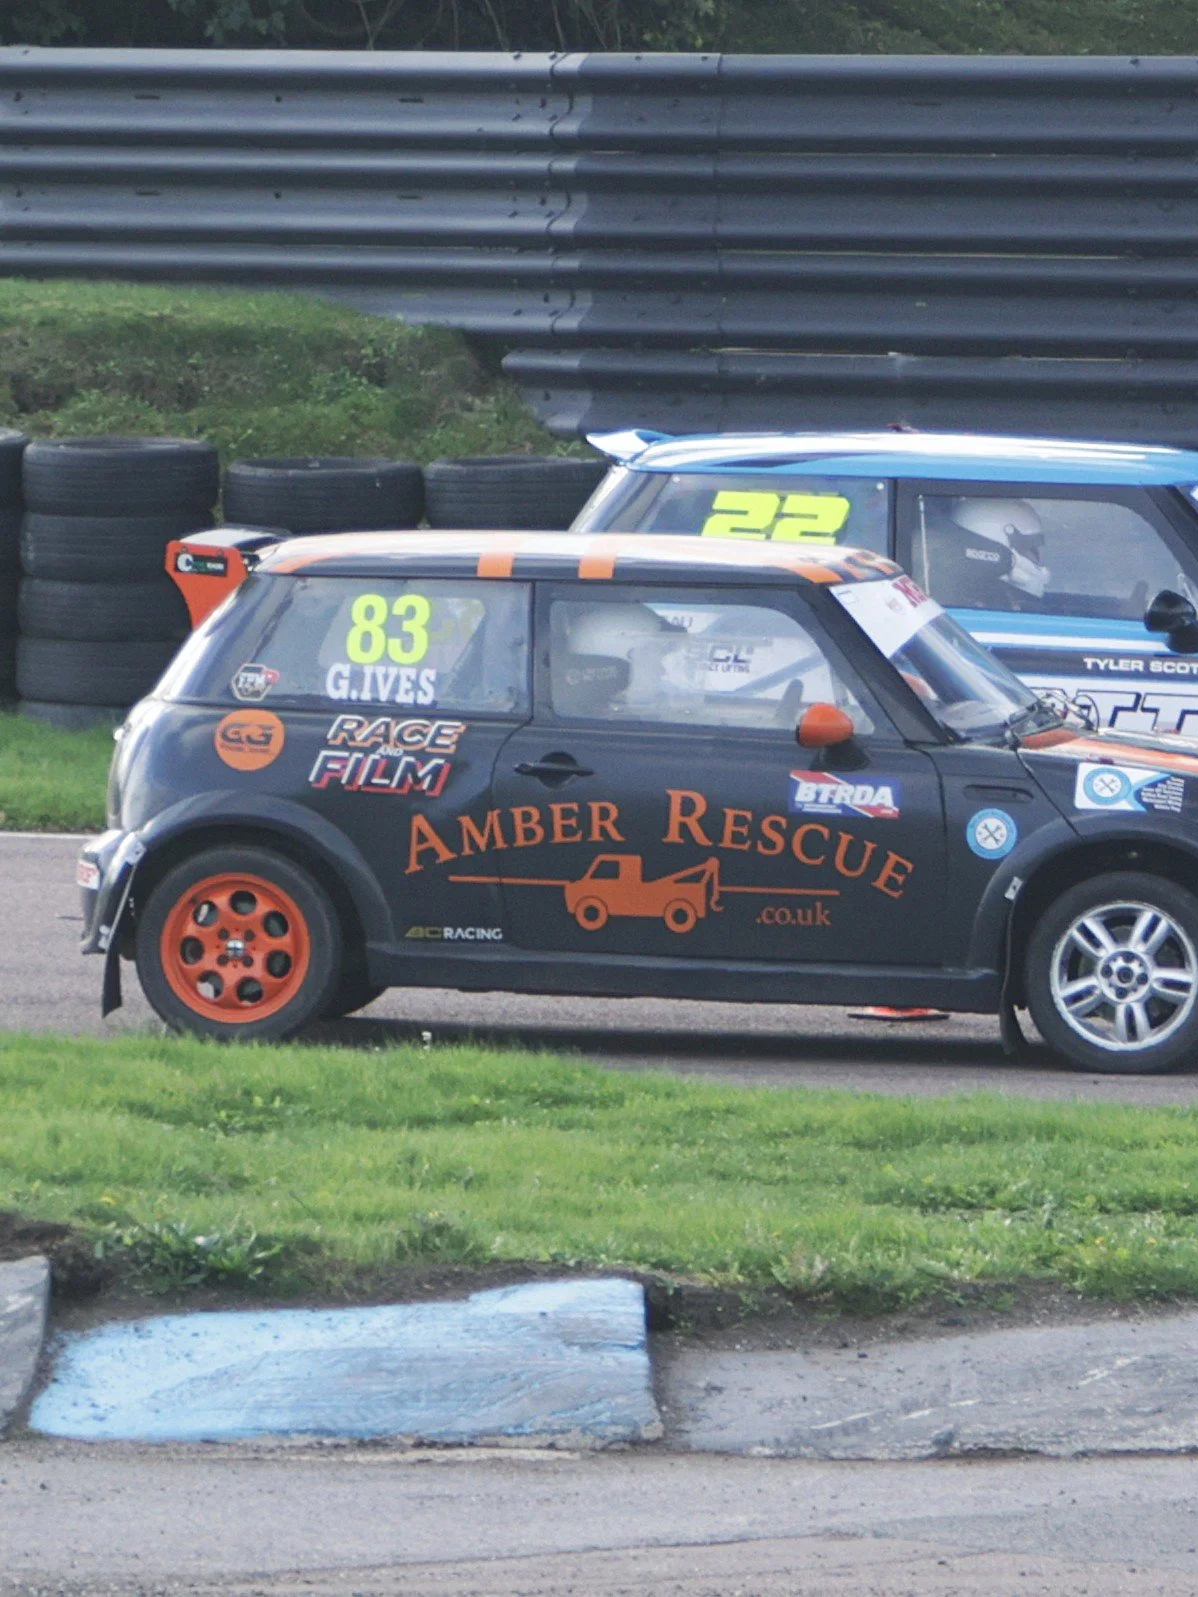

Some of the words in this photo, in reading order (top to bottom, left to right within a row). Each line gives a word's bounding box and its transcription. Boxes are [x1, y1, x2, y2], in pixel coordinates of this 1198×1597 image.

[701, 491, 850, 545] 22
[346, 593, 431, 665] 83
[325, 663, 437, 704] G.IVES
[1083, 657, 1144, 672] TYLER
[326, 714, 467, 753] RACE
[376, 746, 404, 758] AND
[308, 750, 452, 796] FILM
[795, 781, 895, 807] BTRDA
[404, 801, 626, 874] AMBER
[662, 789, 915, 898] RESCUE
[755, 901, 833, 926] .co.uk
[443, 927, 503, 940] RACING
